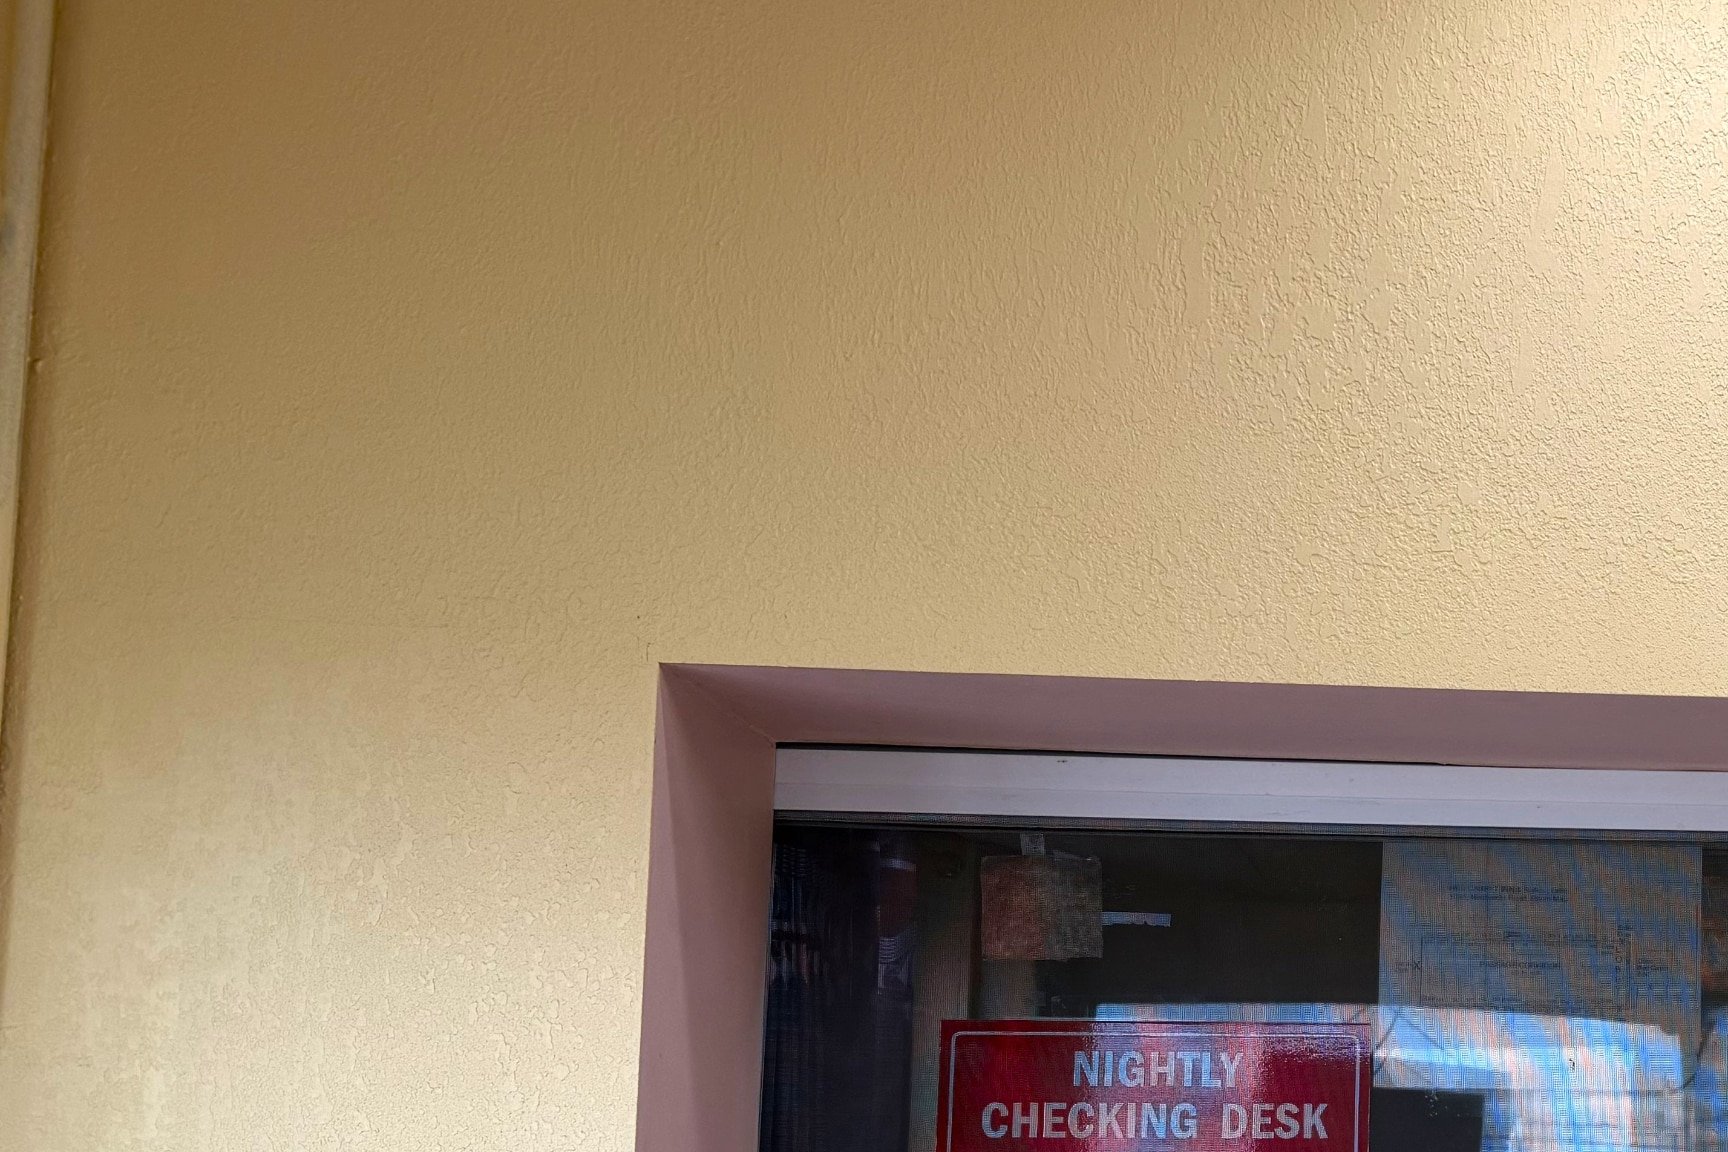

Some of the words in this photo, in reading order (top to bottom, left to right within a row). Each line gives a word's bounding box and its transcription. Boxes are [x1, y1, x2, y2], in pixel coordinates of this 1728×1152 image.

[1073, 1050, 1244, 1088] NIGHTLY
[981, 1101, 1197, 1139] CHECKING
[1221, 1102, 1329, 1140] DESK
